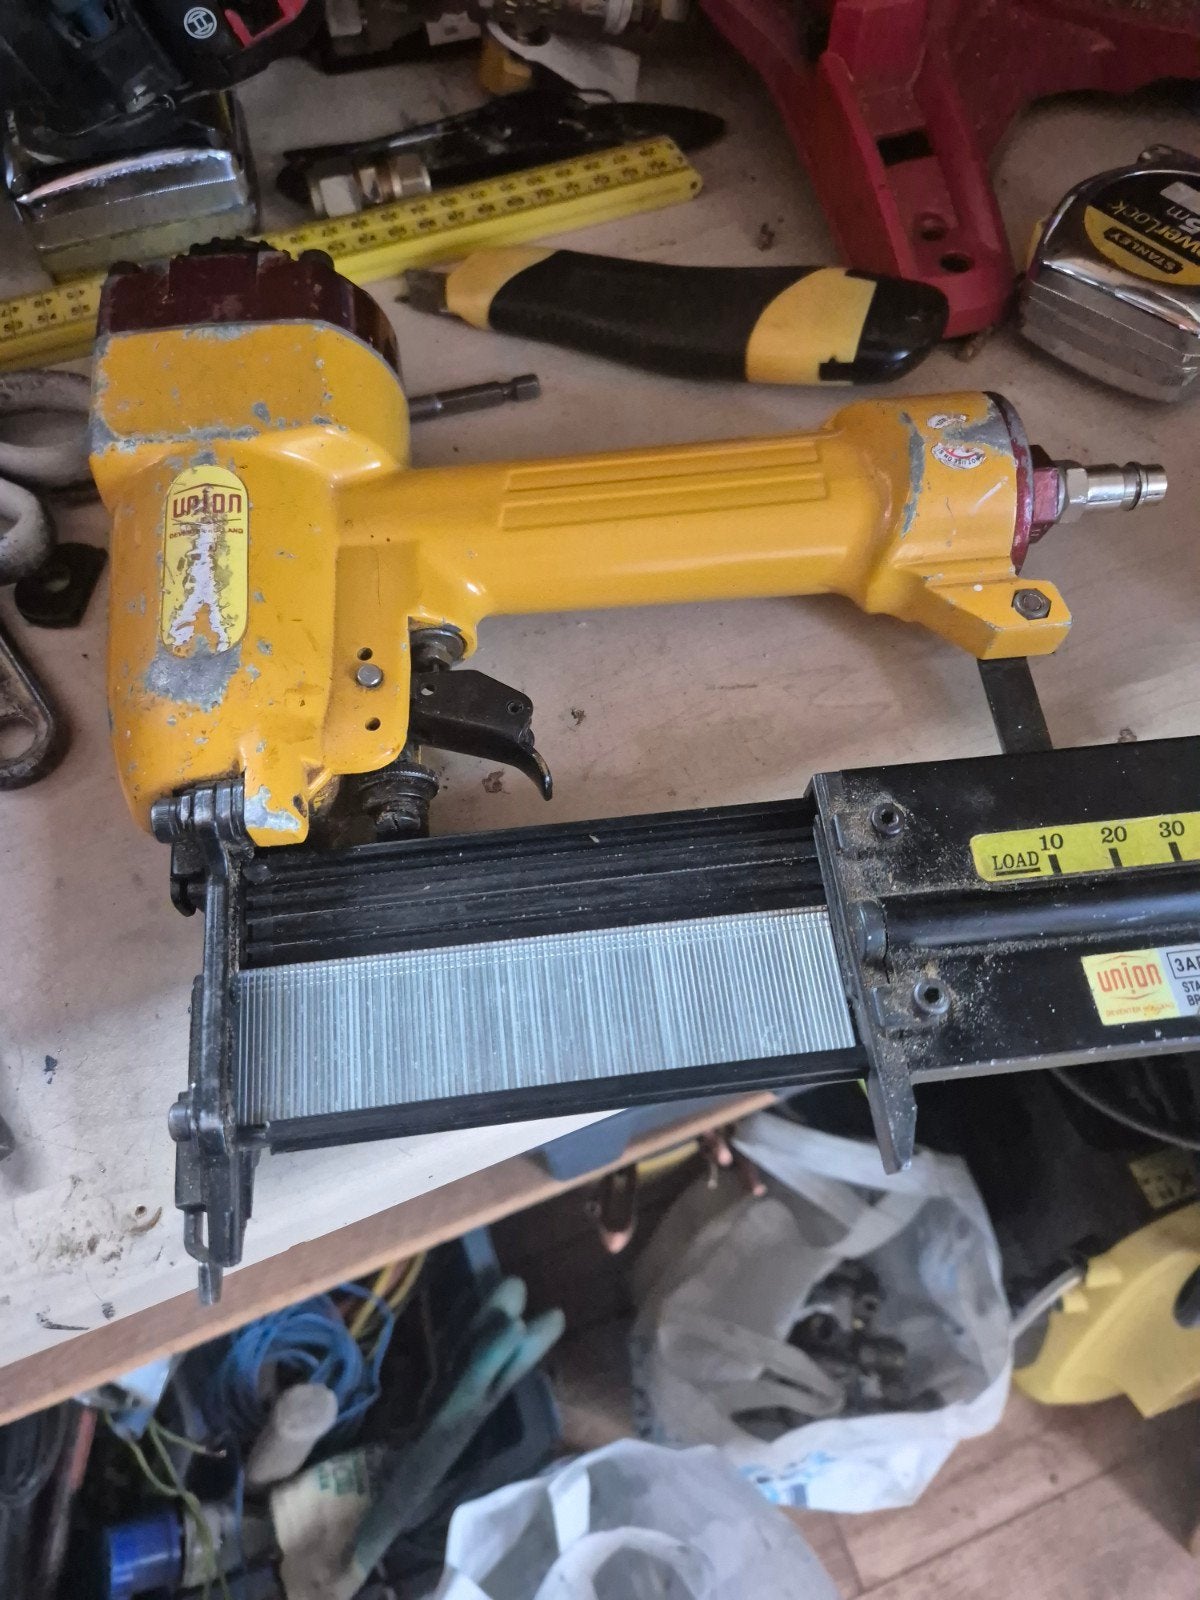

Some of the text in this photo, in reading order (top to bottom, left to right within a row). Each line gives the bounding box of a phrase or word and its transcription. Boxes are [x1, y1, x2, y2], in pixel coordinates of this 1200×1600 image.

[1109, 231, 1177, 271] STANLEY
[991, 820, 1185, 871] LOAD 10 20 30
